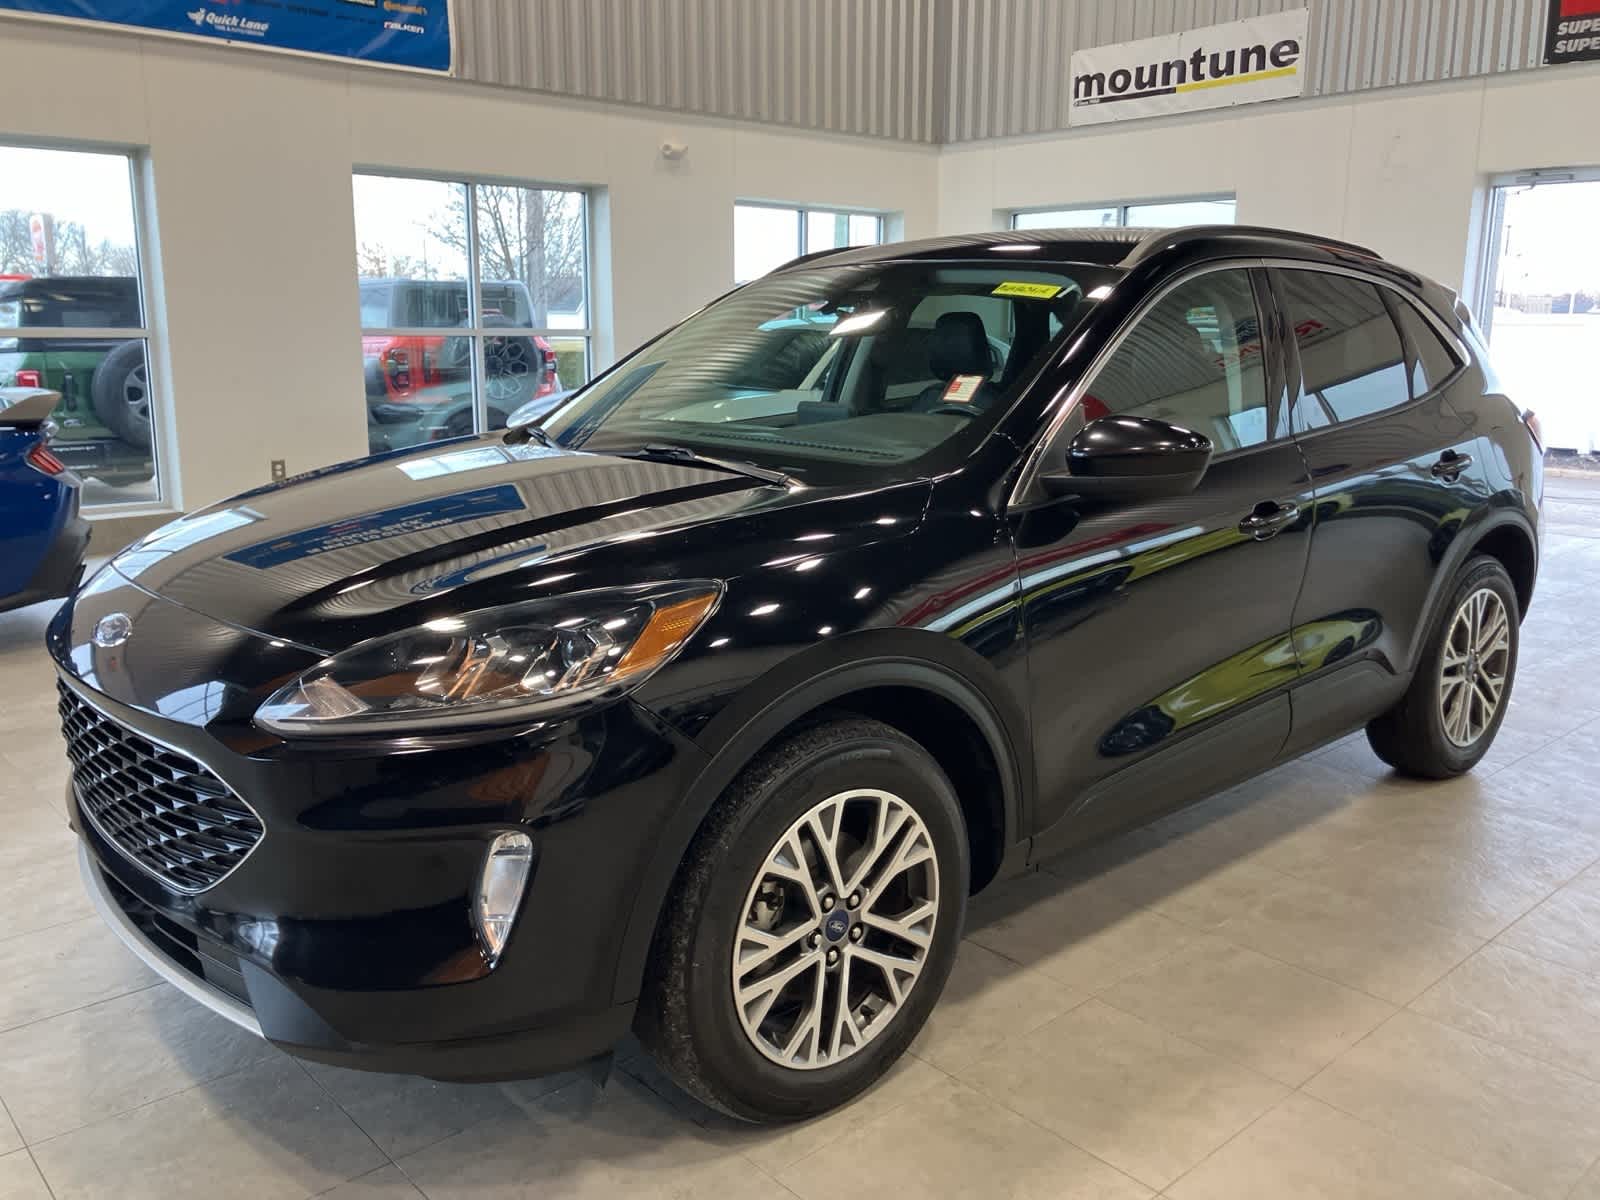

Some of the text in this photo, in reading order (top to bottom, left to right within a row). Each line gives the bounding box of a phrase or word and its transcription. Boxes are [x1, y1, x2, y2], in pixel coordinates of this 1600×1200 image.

[206, 12, 239, 26] Quick
[240, 17, 269, 31] Lane
[1073, 39, 1299, 98] mountune
